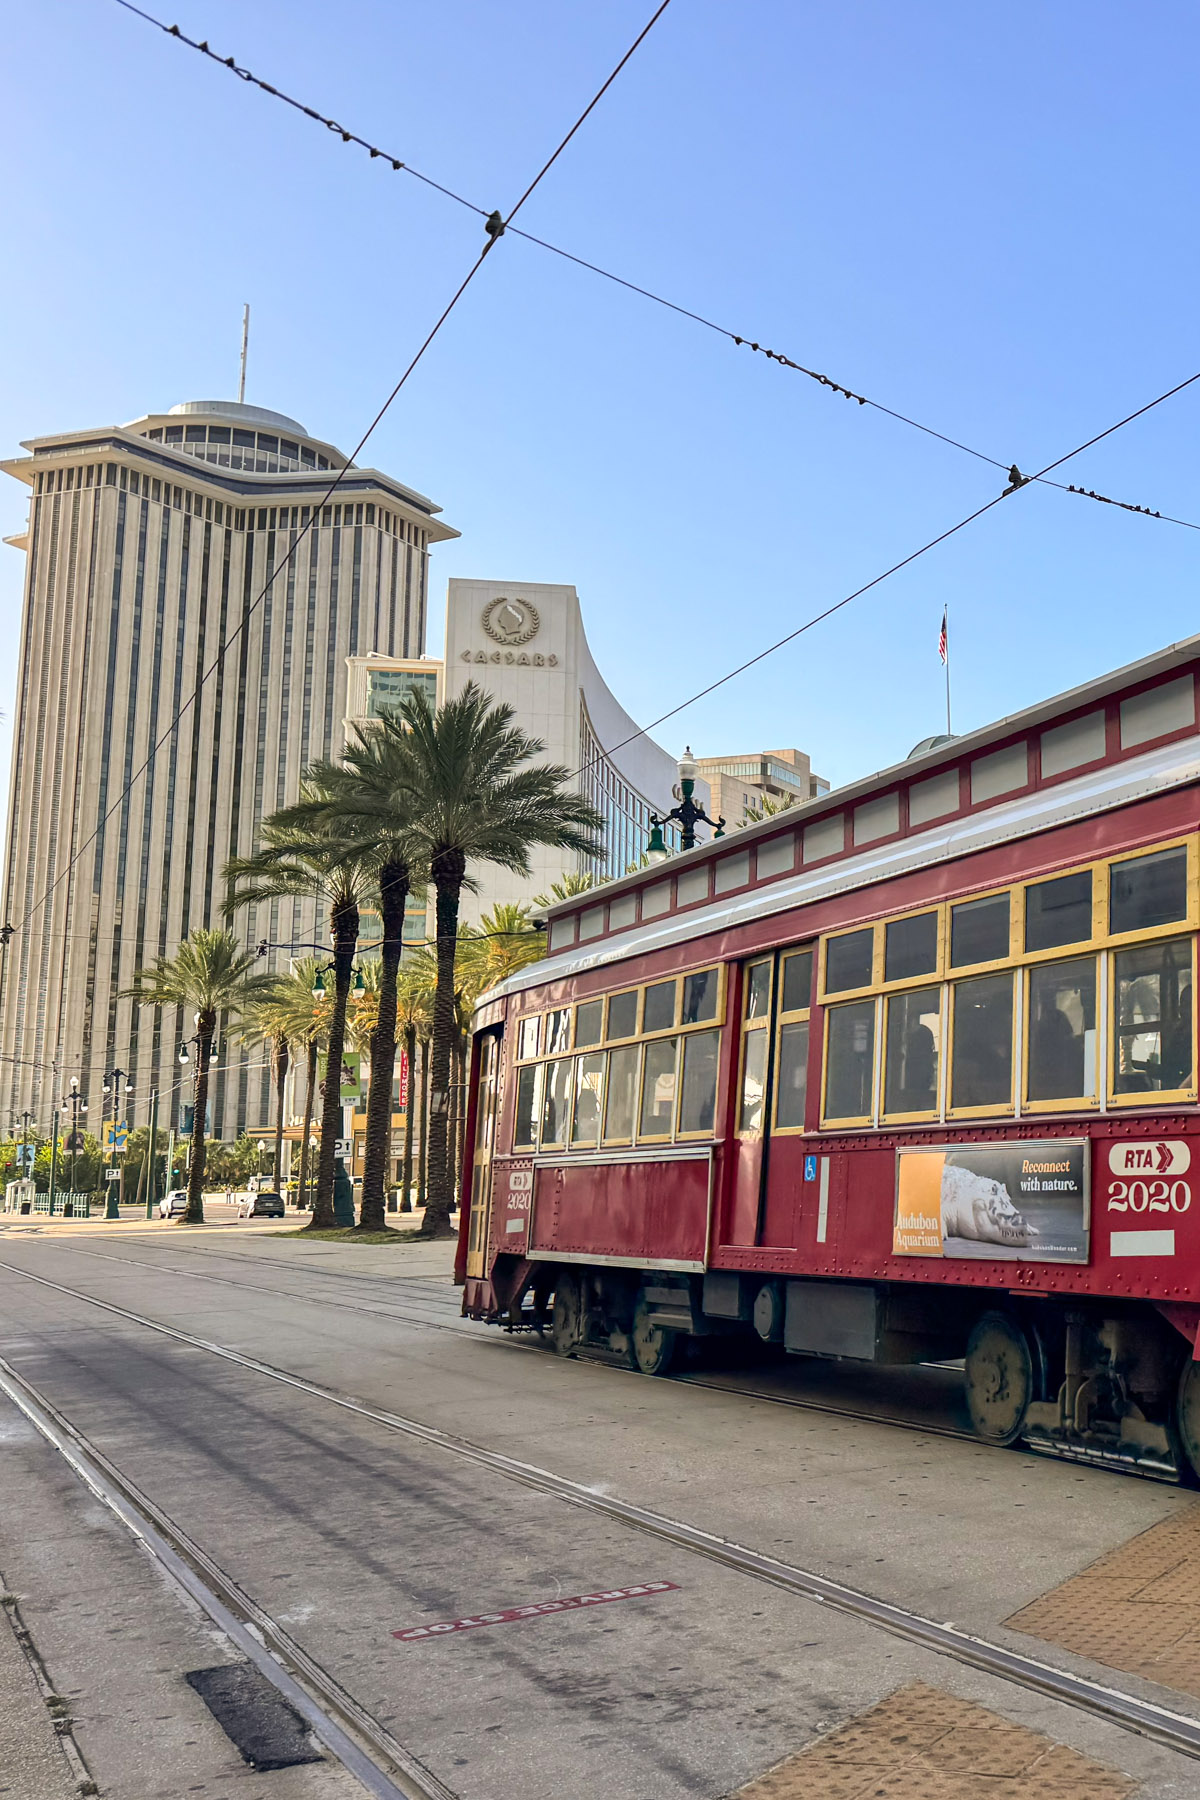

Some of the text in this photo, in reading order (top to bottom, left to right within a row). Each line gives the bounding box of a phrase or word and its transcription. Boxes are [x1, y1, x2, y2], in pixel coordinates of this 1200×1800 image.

[461, 649, 558, 668] CAESARS
[1022, 1159, 1071, 1173] Reconnect
[1124, 1149, 1153, 1168] RTA
[1020, 1177, 1078, 1191] with nature.
[507, 1193, 531, 1210] 2020
[1107, 1181, 1192, 1213] 2020
[896, 1211, 938, 1230] Audubon
[897, 1231, 940, 1250] Aquarium
[402, 1582, 670, 1638] SERVICE STOP
